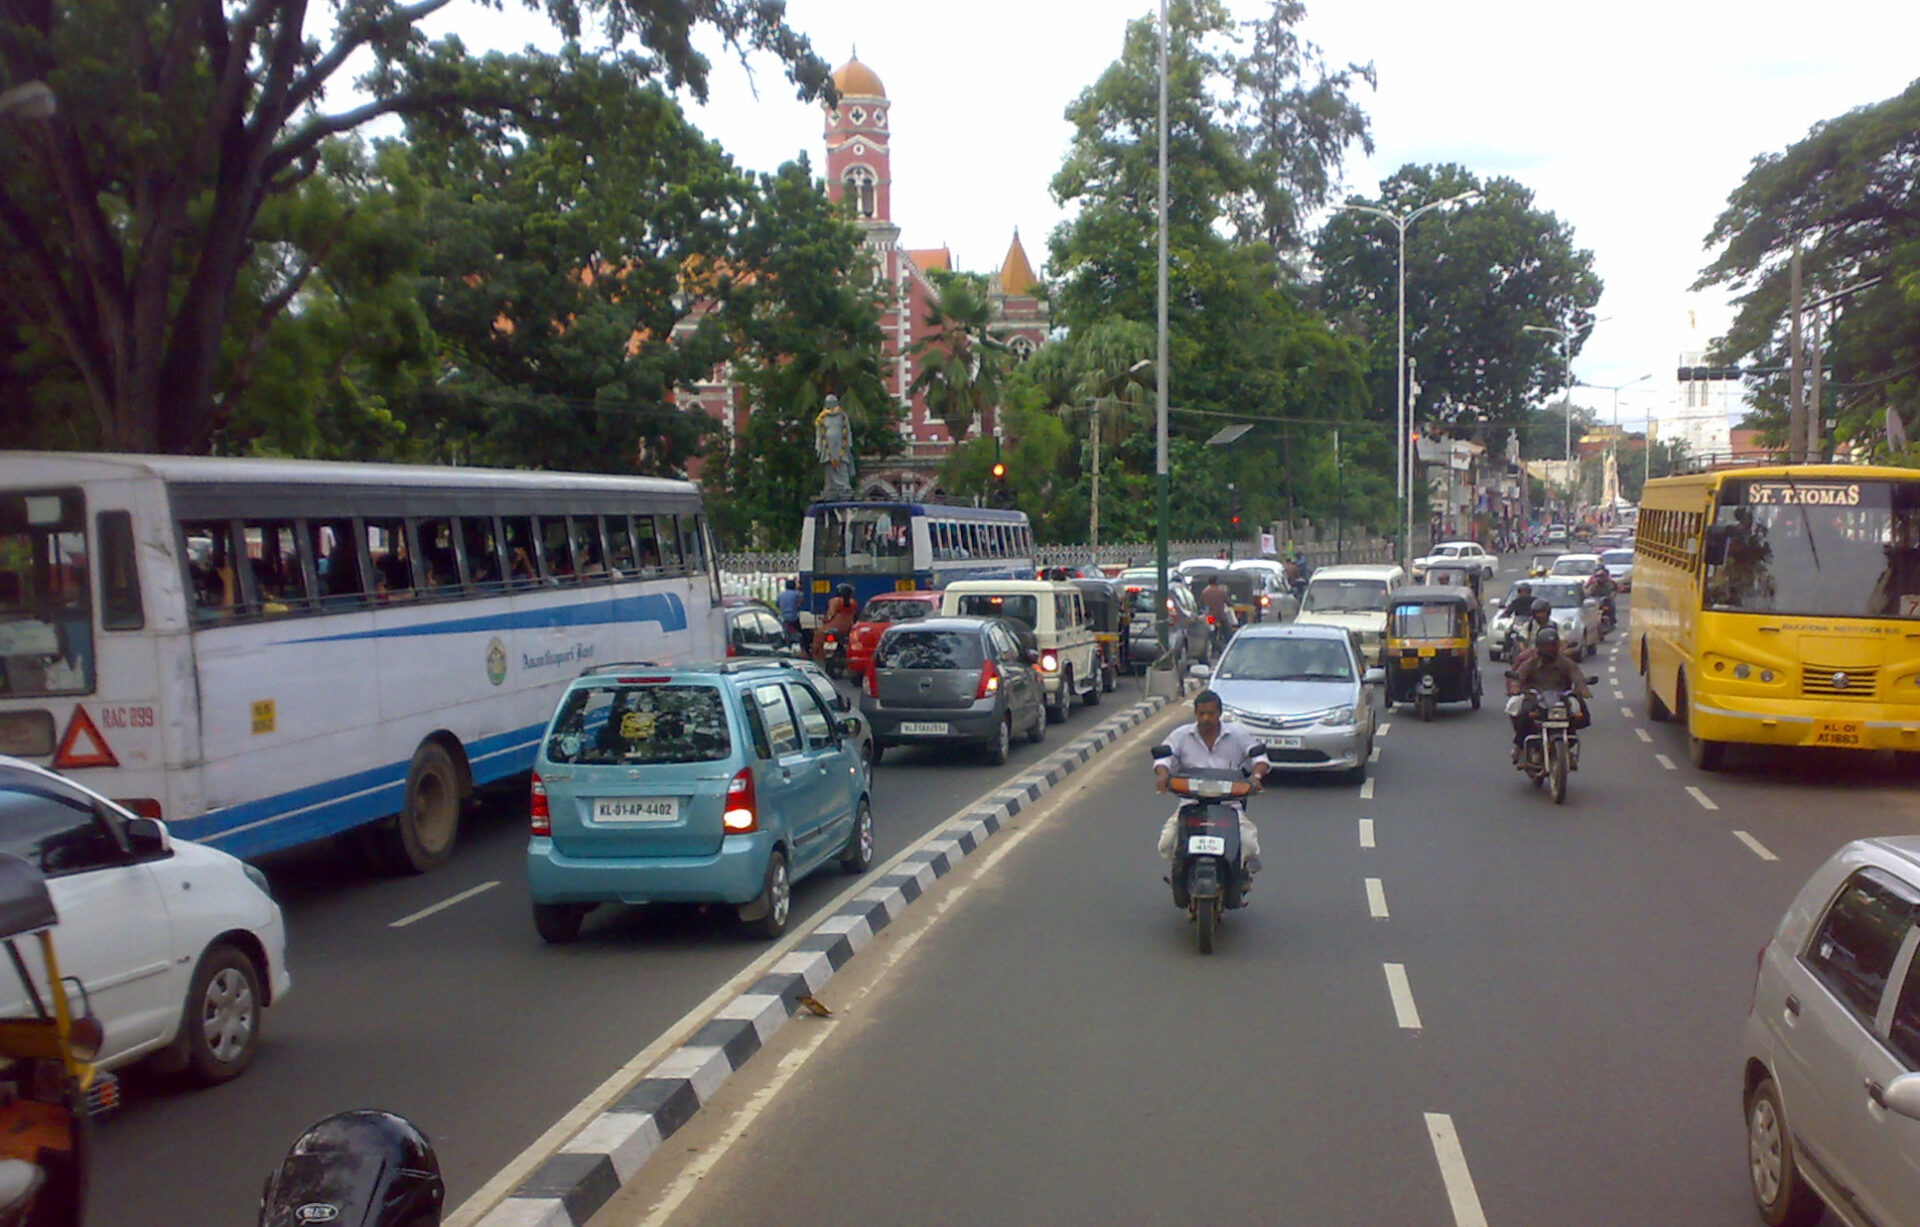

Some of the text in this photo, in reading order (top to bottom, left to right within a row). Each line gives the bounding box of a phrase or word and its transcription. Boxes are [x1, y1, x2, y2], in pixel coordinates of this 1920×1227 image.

[1749, 483, 1860, 506] ST. THOMAS
[102, 707, 127, 728] RAC
